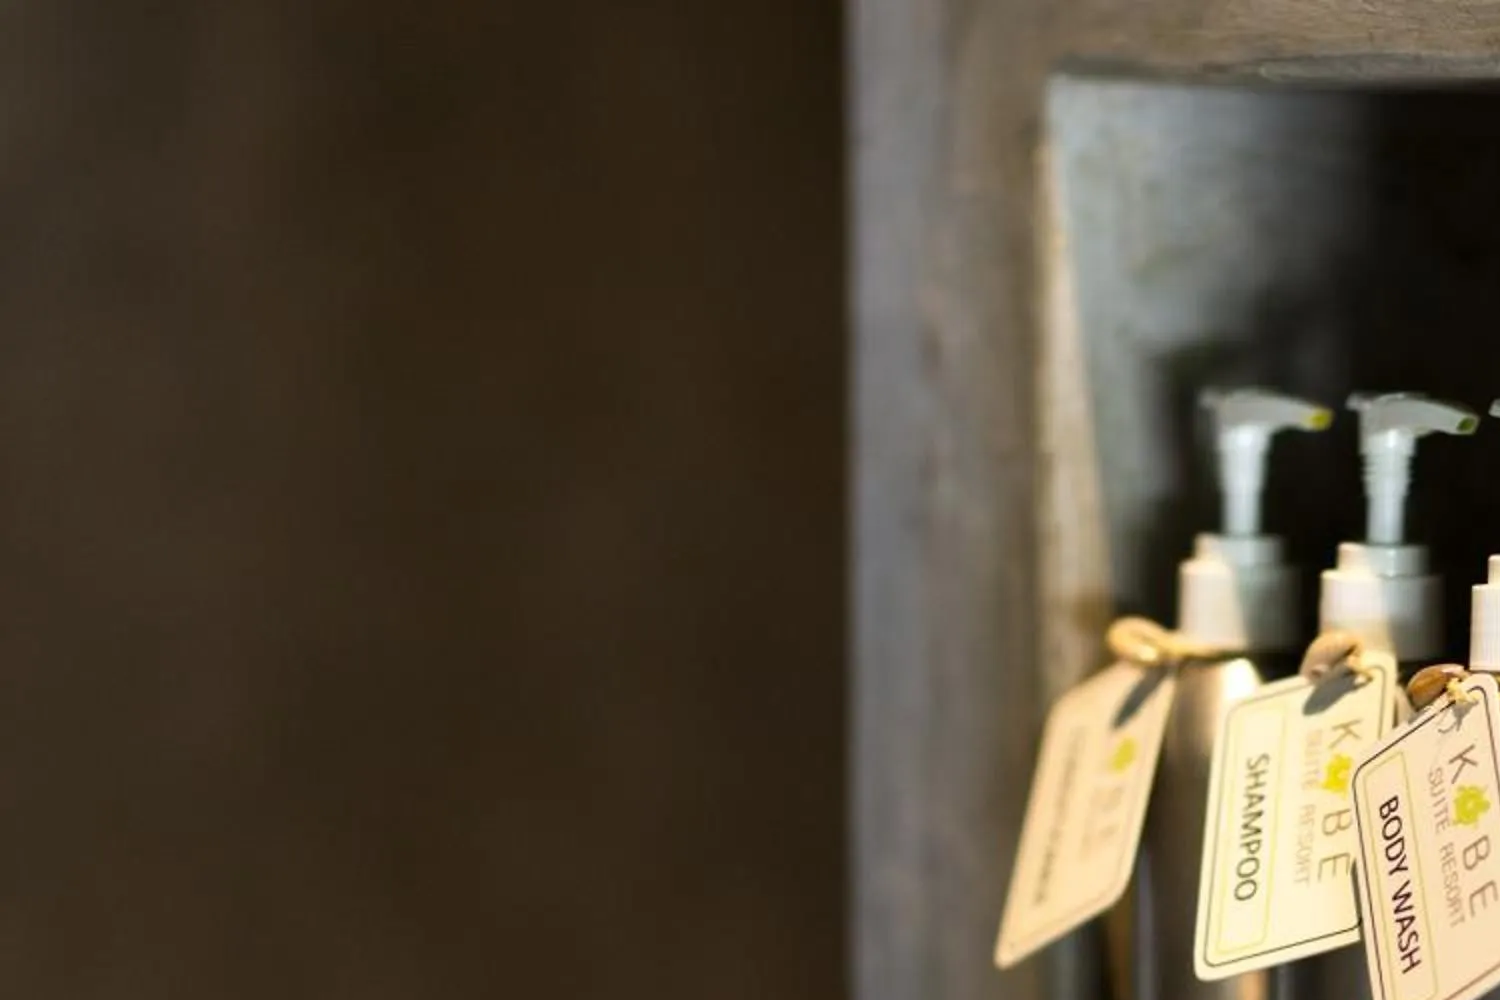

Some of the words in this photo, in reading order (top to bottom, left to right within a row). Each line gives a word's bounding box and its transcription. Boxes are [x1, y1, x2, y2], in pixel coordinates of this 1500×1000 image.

[1233, 752, 1270, 902] SHAMPOO
[1379, 795, 1409, 876] BODY
[1426, 766, 1450, 835] SUITE
[1439, 842, 1466, 930] RESORT
[1391, 878, 1423, 974] WASH
